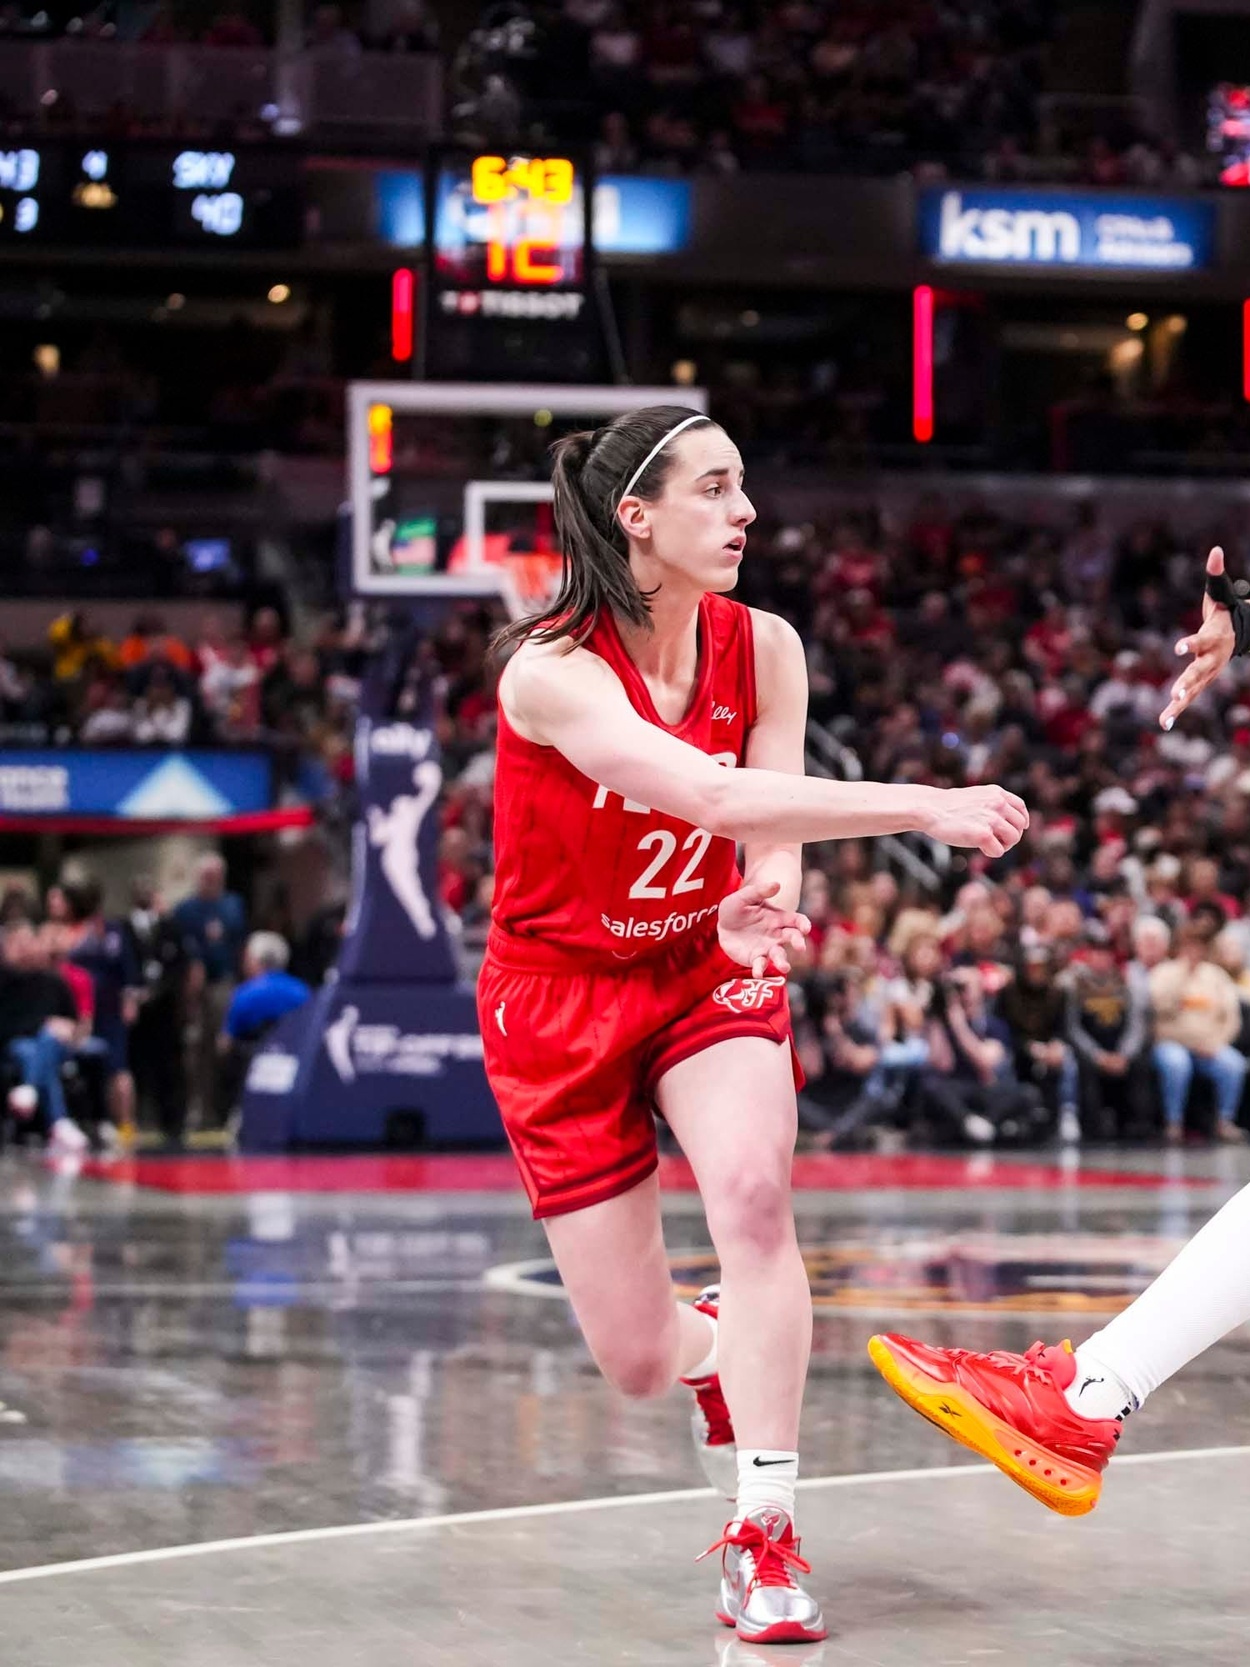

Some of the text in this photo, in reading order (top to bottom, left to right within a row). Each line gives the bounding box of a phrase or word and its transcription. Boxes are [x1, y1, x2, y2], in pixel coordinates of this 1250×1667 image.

[939, 190, 1082, 261] ksm
[711, 701, 738, 725] lly
[628, 827, 713, 900] 22
